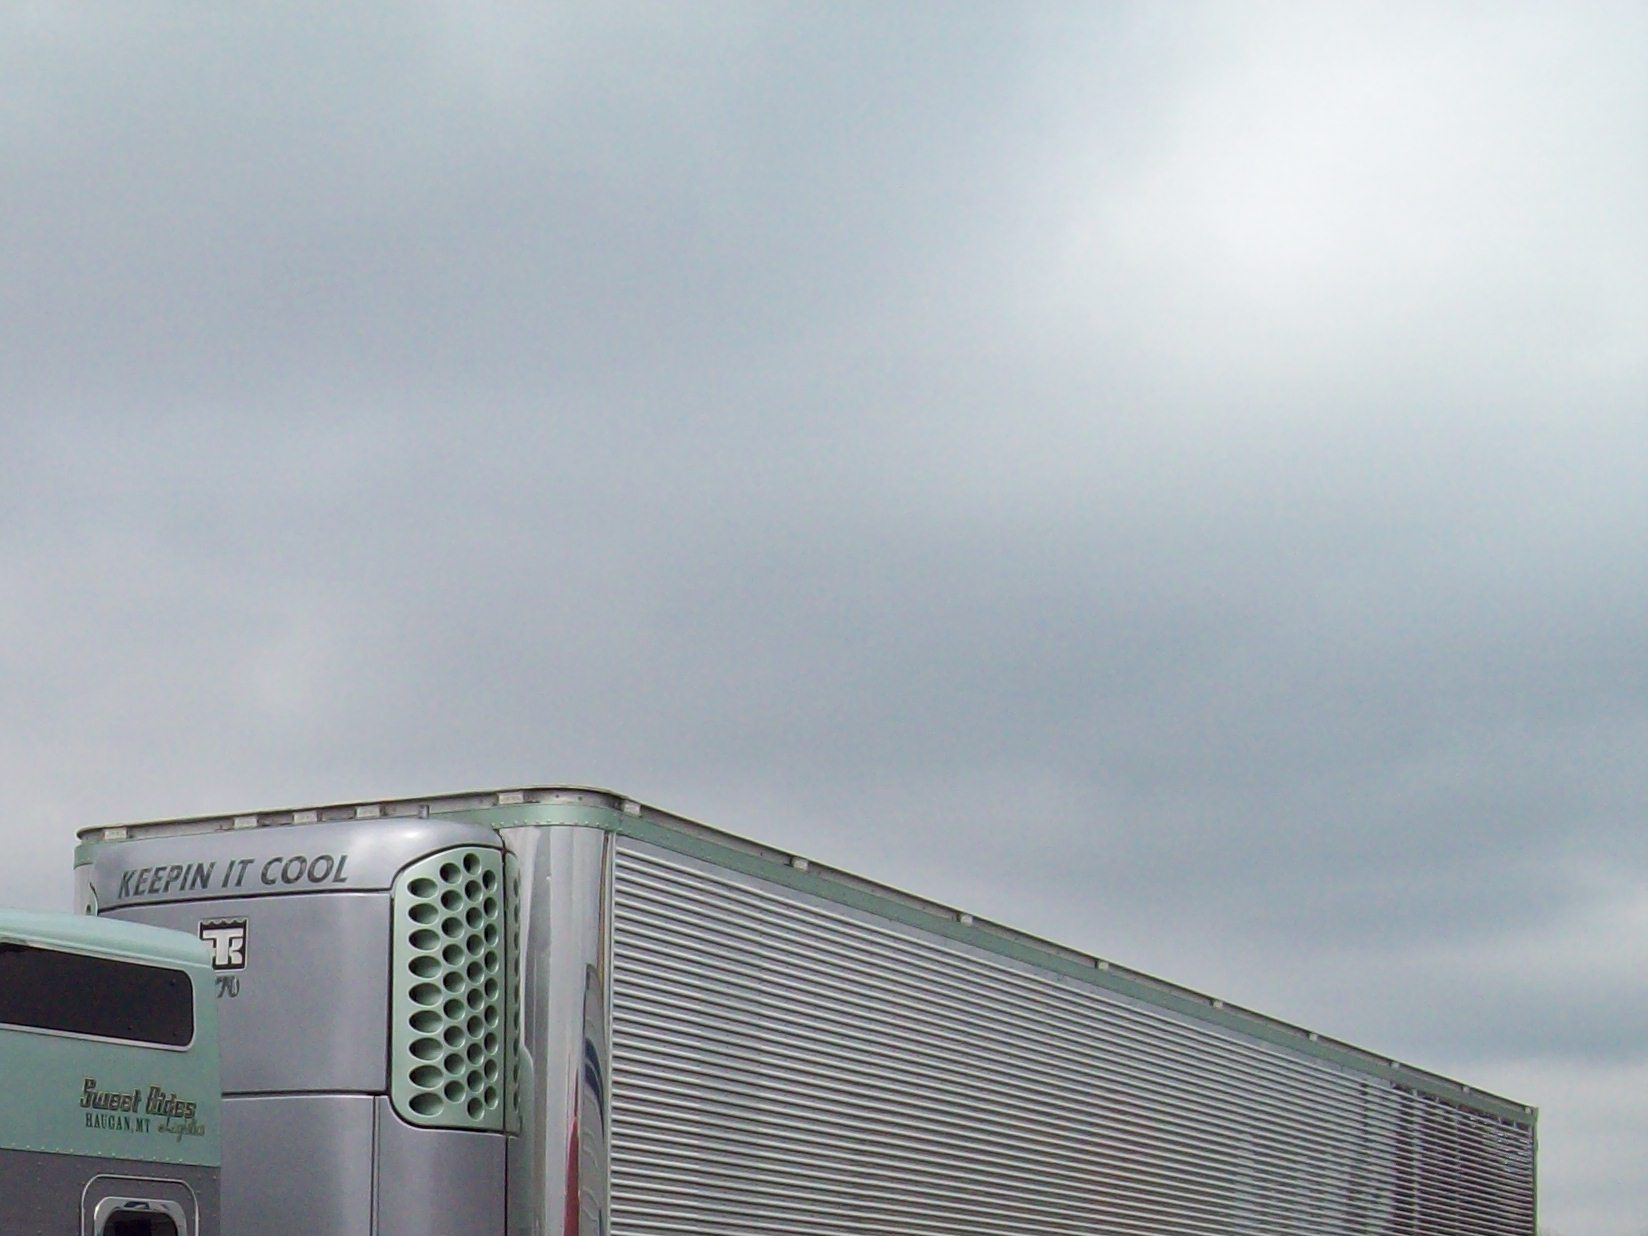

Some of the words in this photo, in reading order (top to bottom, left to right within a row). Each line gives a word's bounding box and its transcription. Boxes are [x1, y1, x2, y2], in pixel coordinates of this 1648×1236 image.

[118, 861, 216, 899] KEEPIN
[221, 858, 255, 889] IT
[260, 854, 348, 887] COOL
[79, 1077, 141, 1114] Sweet
